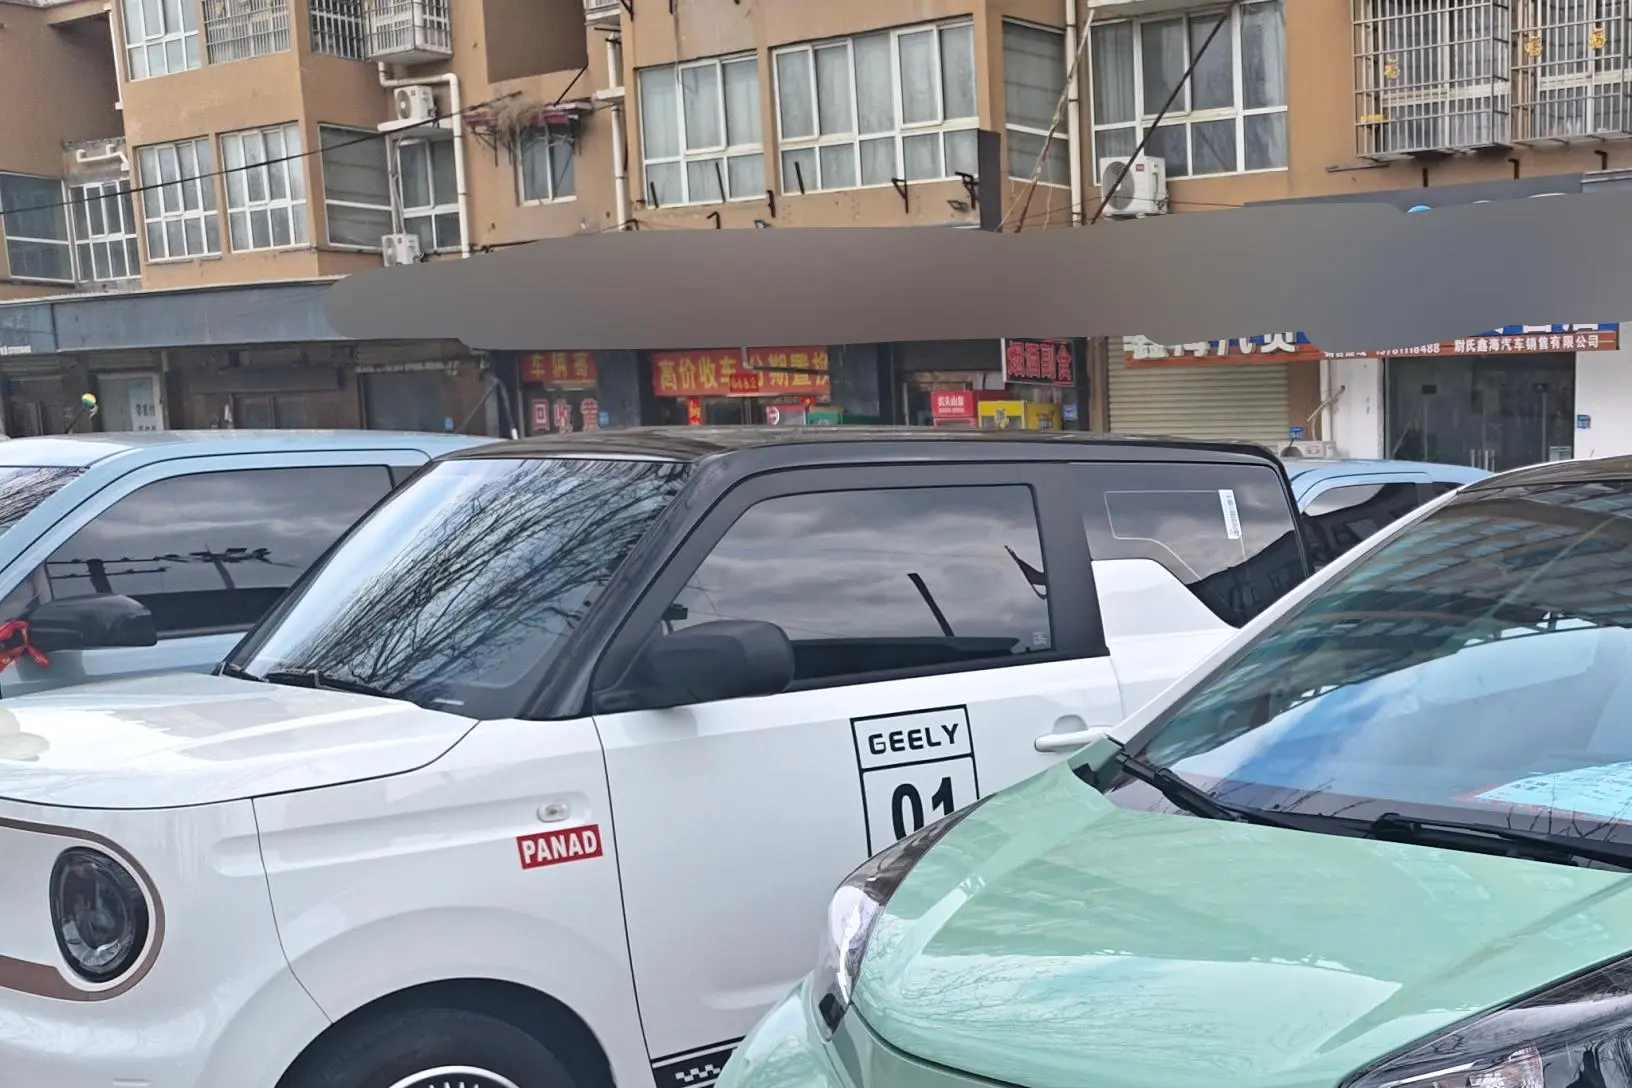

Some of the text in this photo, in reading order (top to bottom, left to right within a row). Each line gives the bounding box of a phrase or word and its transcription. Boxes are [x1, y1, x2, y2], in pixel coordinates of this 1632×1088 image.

[868, 723, 959, 755] GEELY
[891, 777, 955, 840] 01
[521, 830, 599, 866] PANAD
